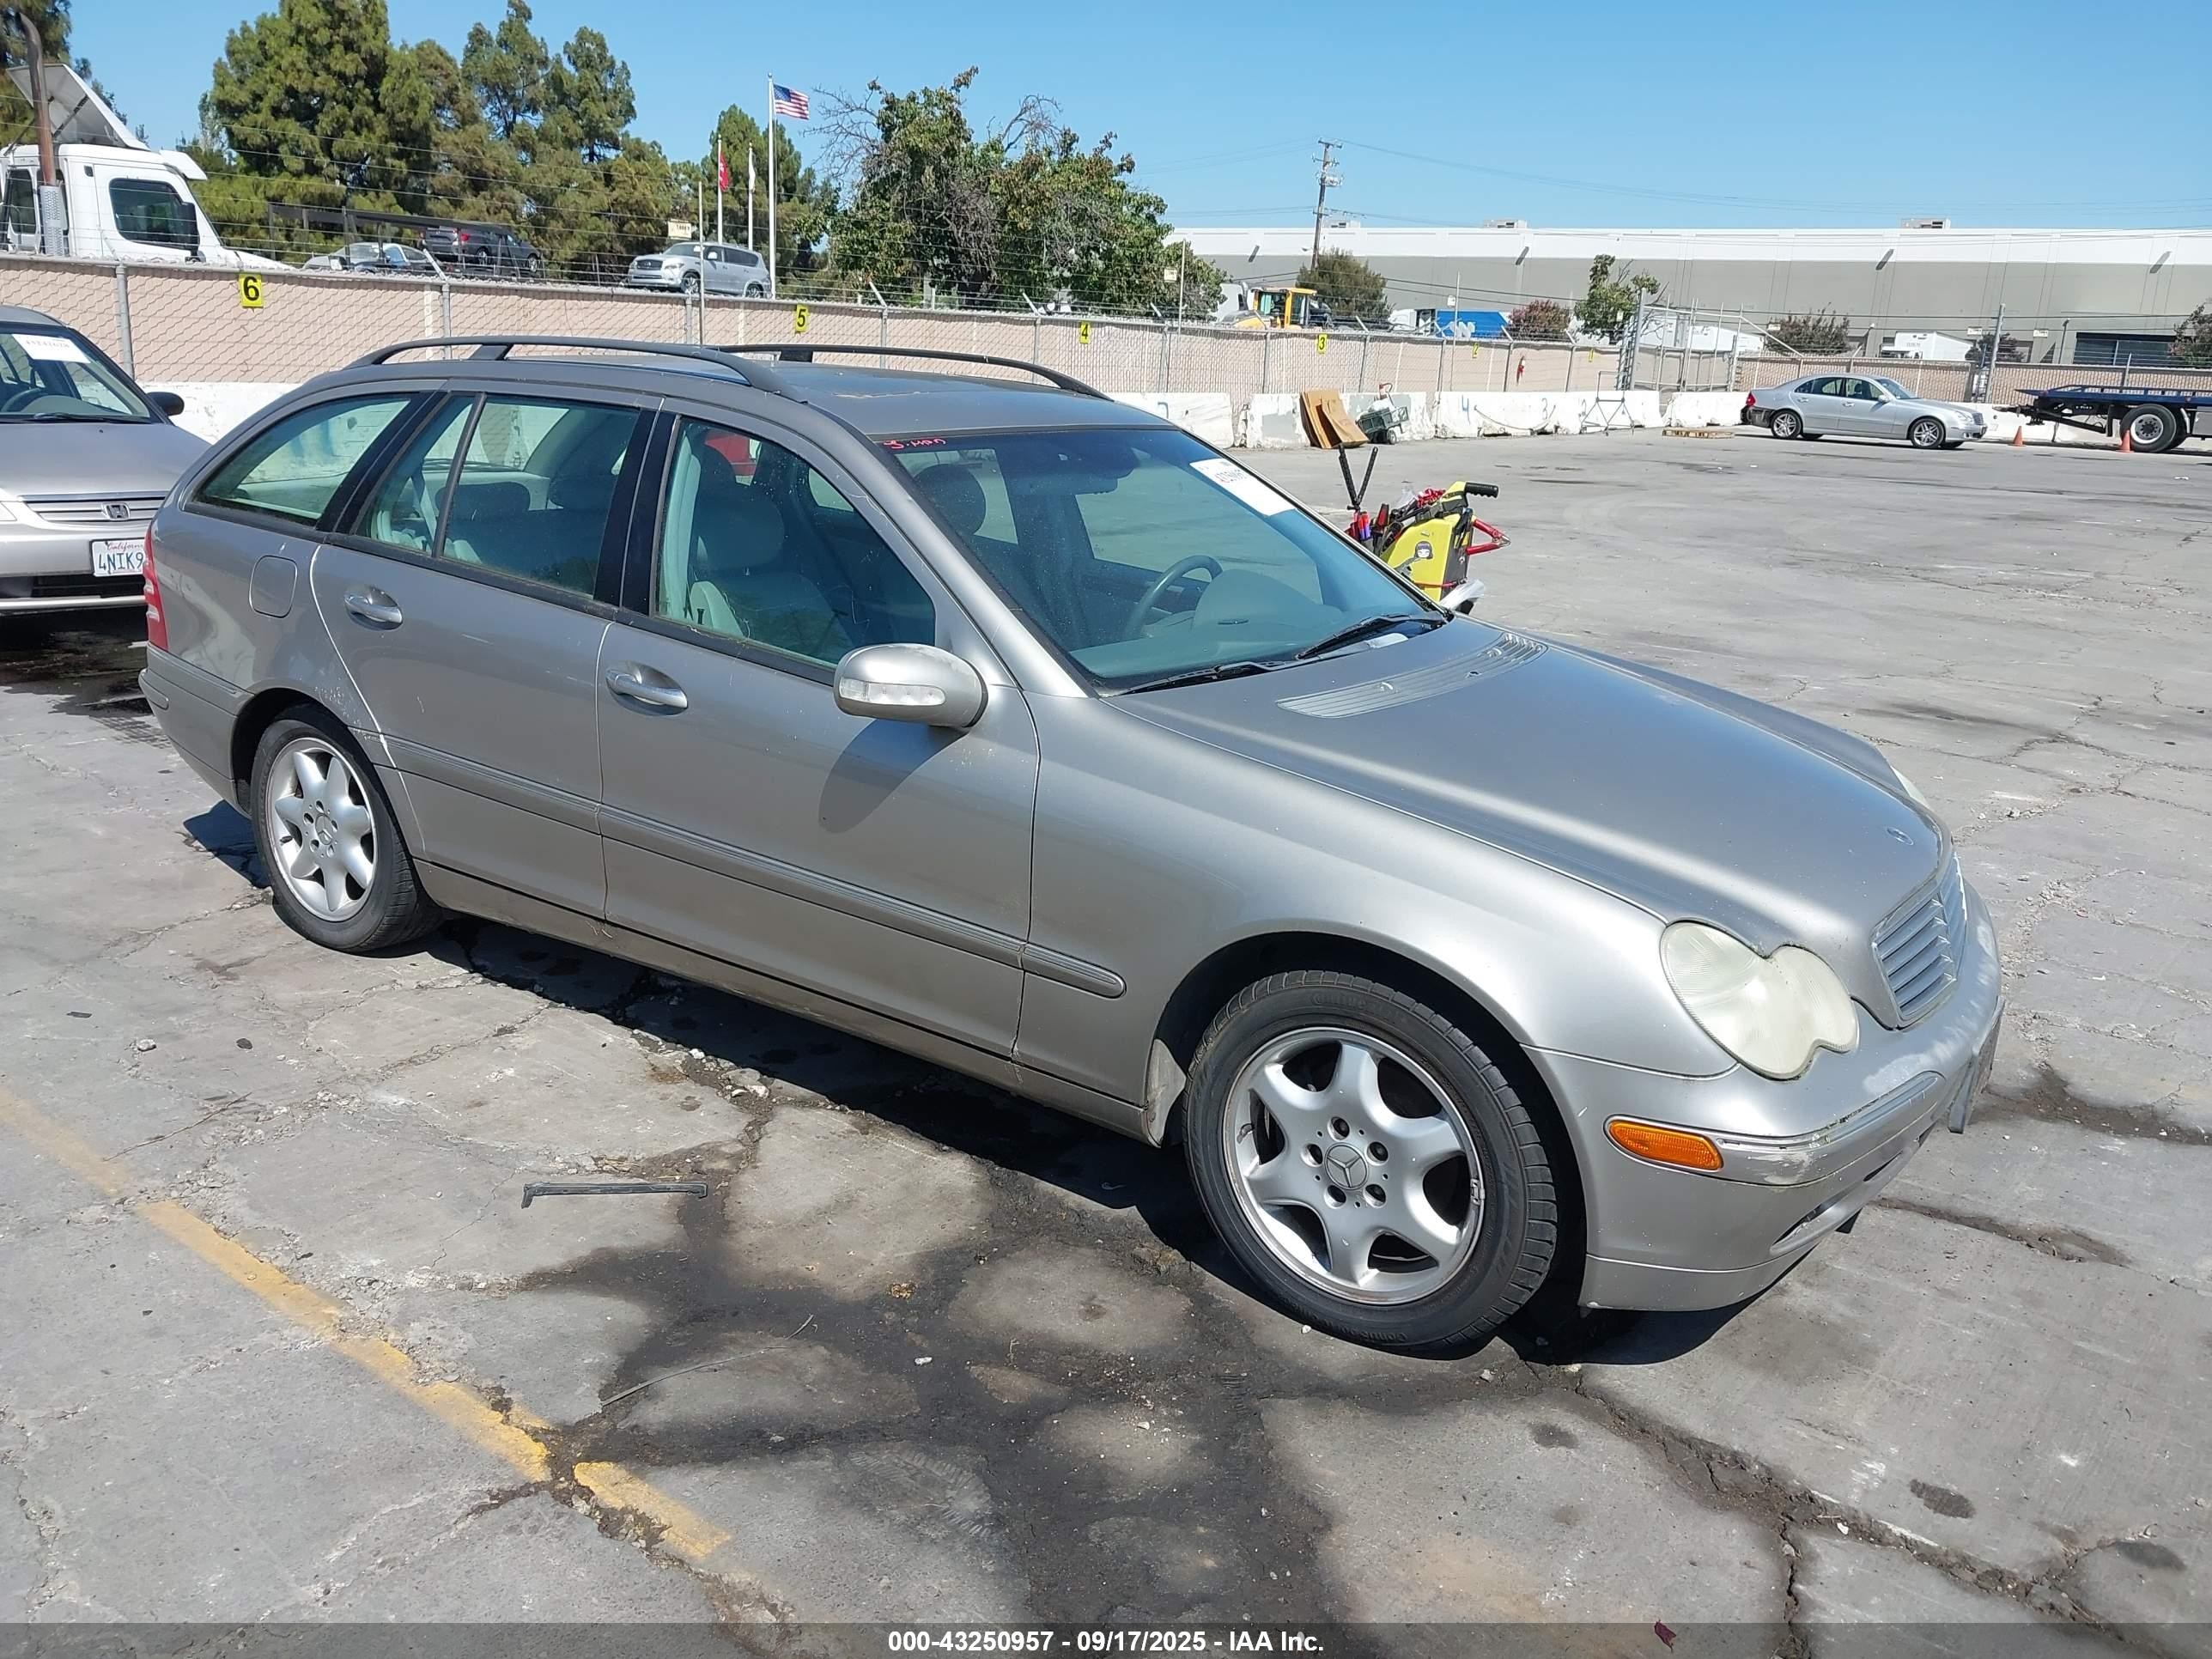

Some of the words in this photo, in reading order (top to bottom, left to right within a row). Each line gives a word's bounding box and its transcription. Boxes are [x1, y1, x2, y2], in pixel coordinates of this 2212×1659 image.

[244, 276, 259, 301] 6
[797, 308, 806, 327] 5
[1082, 323, 1089, 340] 4
[1319, 337, 1326, 350] 3
[1462, 394, 1471, 426] 4
[106, 541, 144, 552] Californi
[99, 552, 144, 571] 4NIK9
